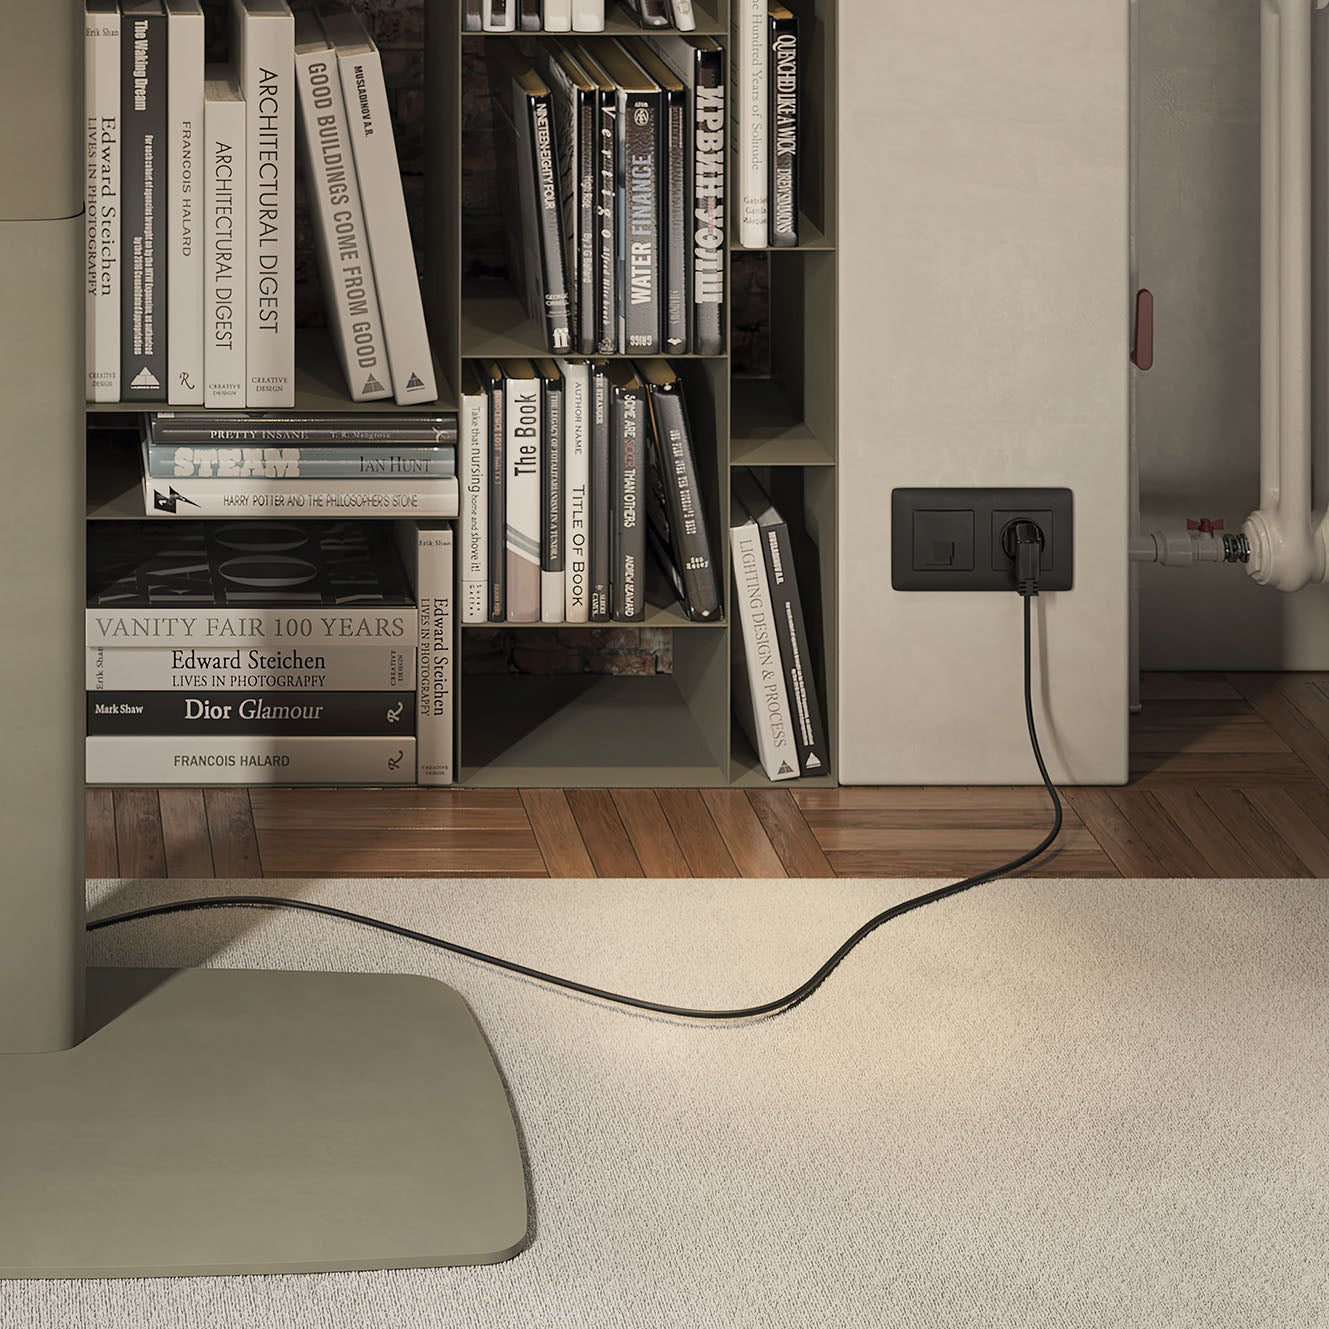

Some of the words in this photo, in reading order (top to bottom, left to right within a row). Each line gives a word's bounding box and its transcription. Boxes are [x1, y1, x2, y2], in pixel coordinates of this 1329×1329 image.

[695, 84, 725, 199] ИРВИН
[258, 67, 279, 248] ARCHITECTURAL
[630, 154, 652, 236] FINANCE
[630, 242, 652, 305] WATER
[259, 255, 278, 334] DIGEST
[471, 406, 481, 427] Take
[471, 428, 481, 446] that
[468, 448, 483, 493] nursing
[470, 532, 481, 561] shove
[470, 562, 481, 573] it!
[95, 617, 198, 637] VANITY
[205, 617, 266, 638] FAIR
[274, 618, 313, 637] 100
[320, 617, 404, 637] YEARS
[171, 649, 242, 670] Edward
[248, 649, 326, 670] Steichen
[172, 675, 208, 687] LIVES
[211, 675, 226, 687] IN
[184, 697, 232, 721] Dior
[238, 697, 324, 721] Glamour
[173, 754, 236, 767] FRANCOIS
[240, 755, 290, 767] HALARD
